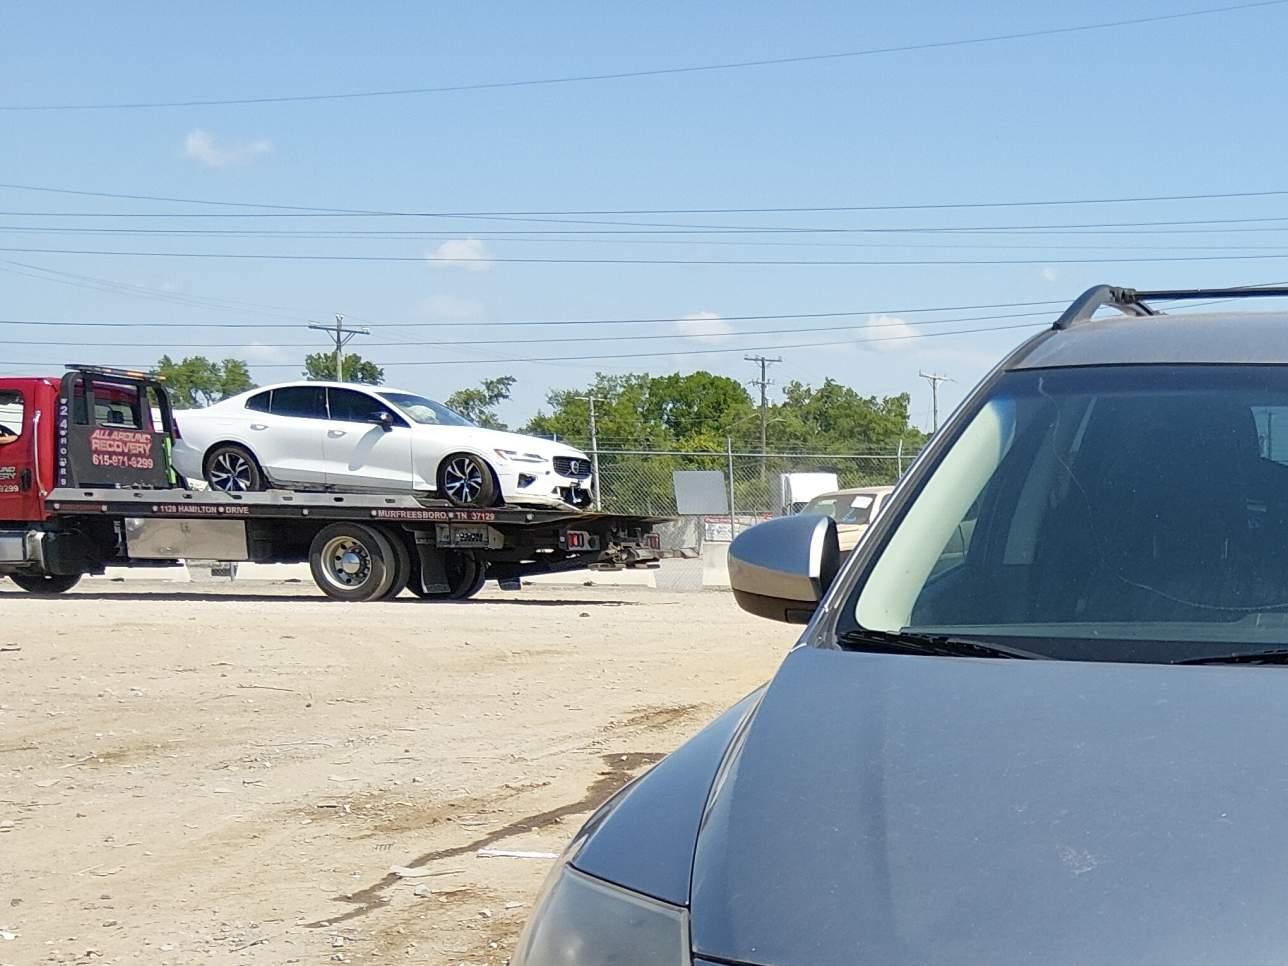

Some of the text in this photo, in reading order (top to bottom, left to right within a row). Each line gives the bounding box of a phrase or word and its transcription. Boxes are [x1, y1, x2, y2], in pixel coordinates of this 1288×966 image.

[91, 429, 152, 443] ALL AROUND
[91, 439, 152, 455] RECOVERY
[178, 505, 217, 513] HAMILTON
[225, 506, 249, 514] DRIVE
[456, 511, 468, 520] TN
[471, 511, 495, 520] 37129
